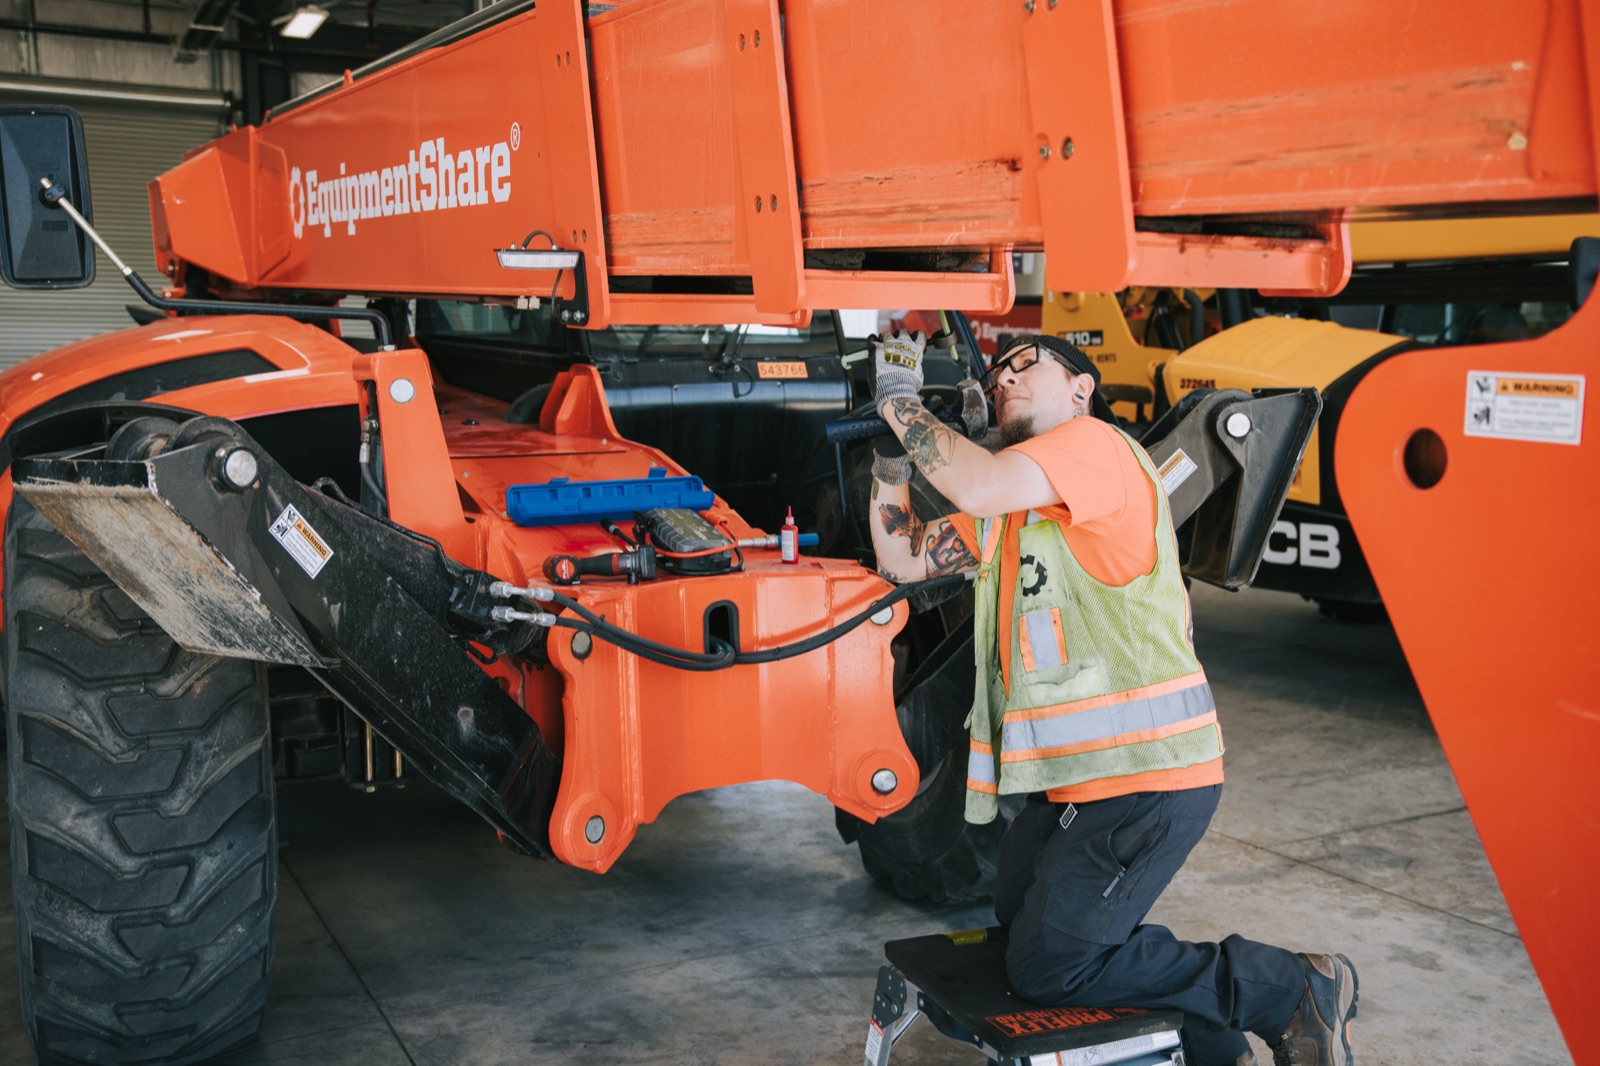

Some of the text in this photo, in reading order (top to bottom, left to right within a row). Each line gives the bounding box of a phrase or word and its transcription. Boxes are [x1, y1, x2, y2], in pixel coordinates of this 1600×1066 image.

[760, 364, 806, 376] 543766
[1513, 383, 1574, 395] WARNING
[301, 527, 327, 557] WARNING
[995, 1013, 1027, 1024] PAD
[1003, 1009, 1113, 1035] PROFLEX
